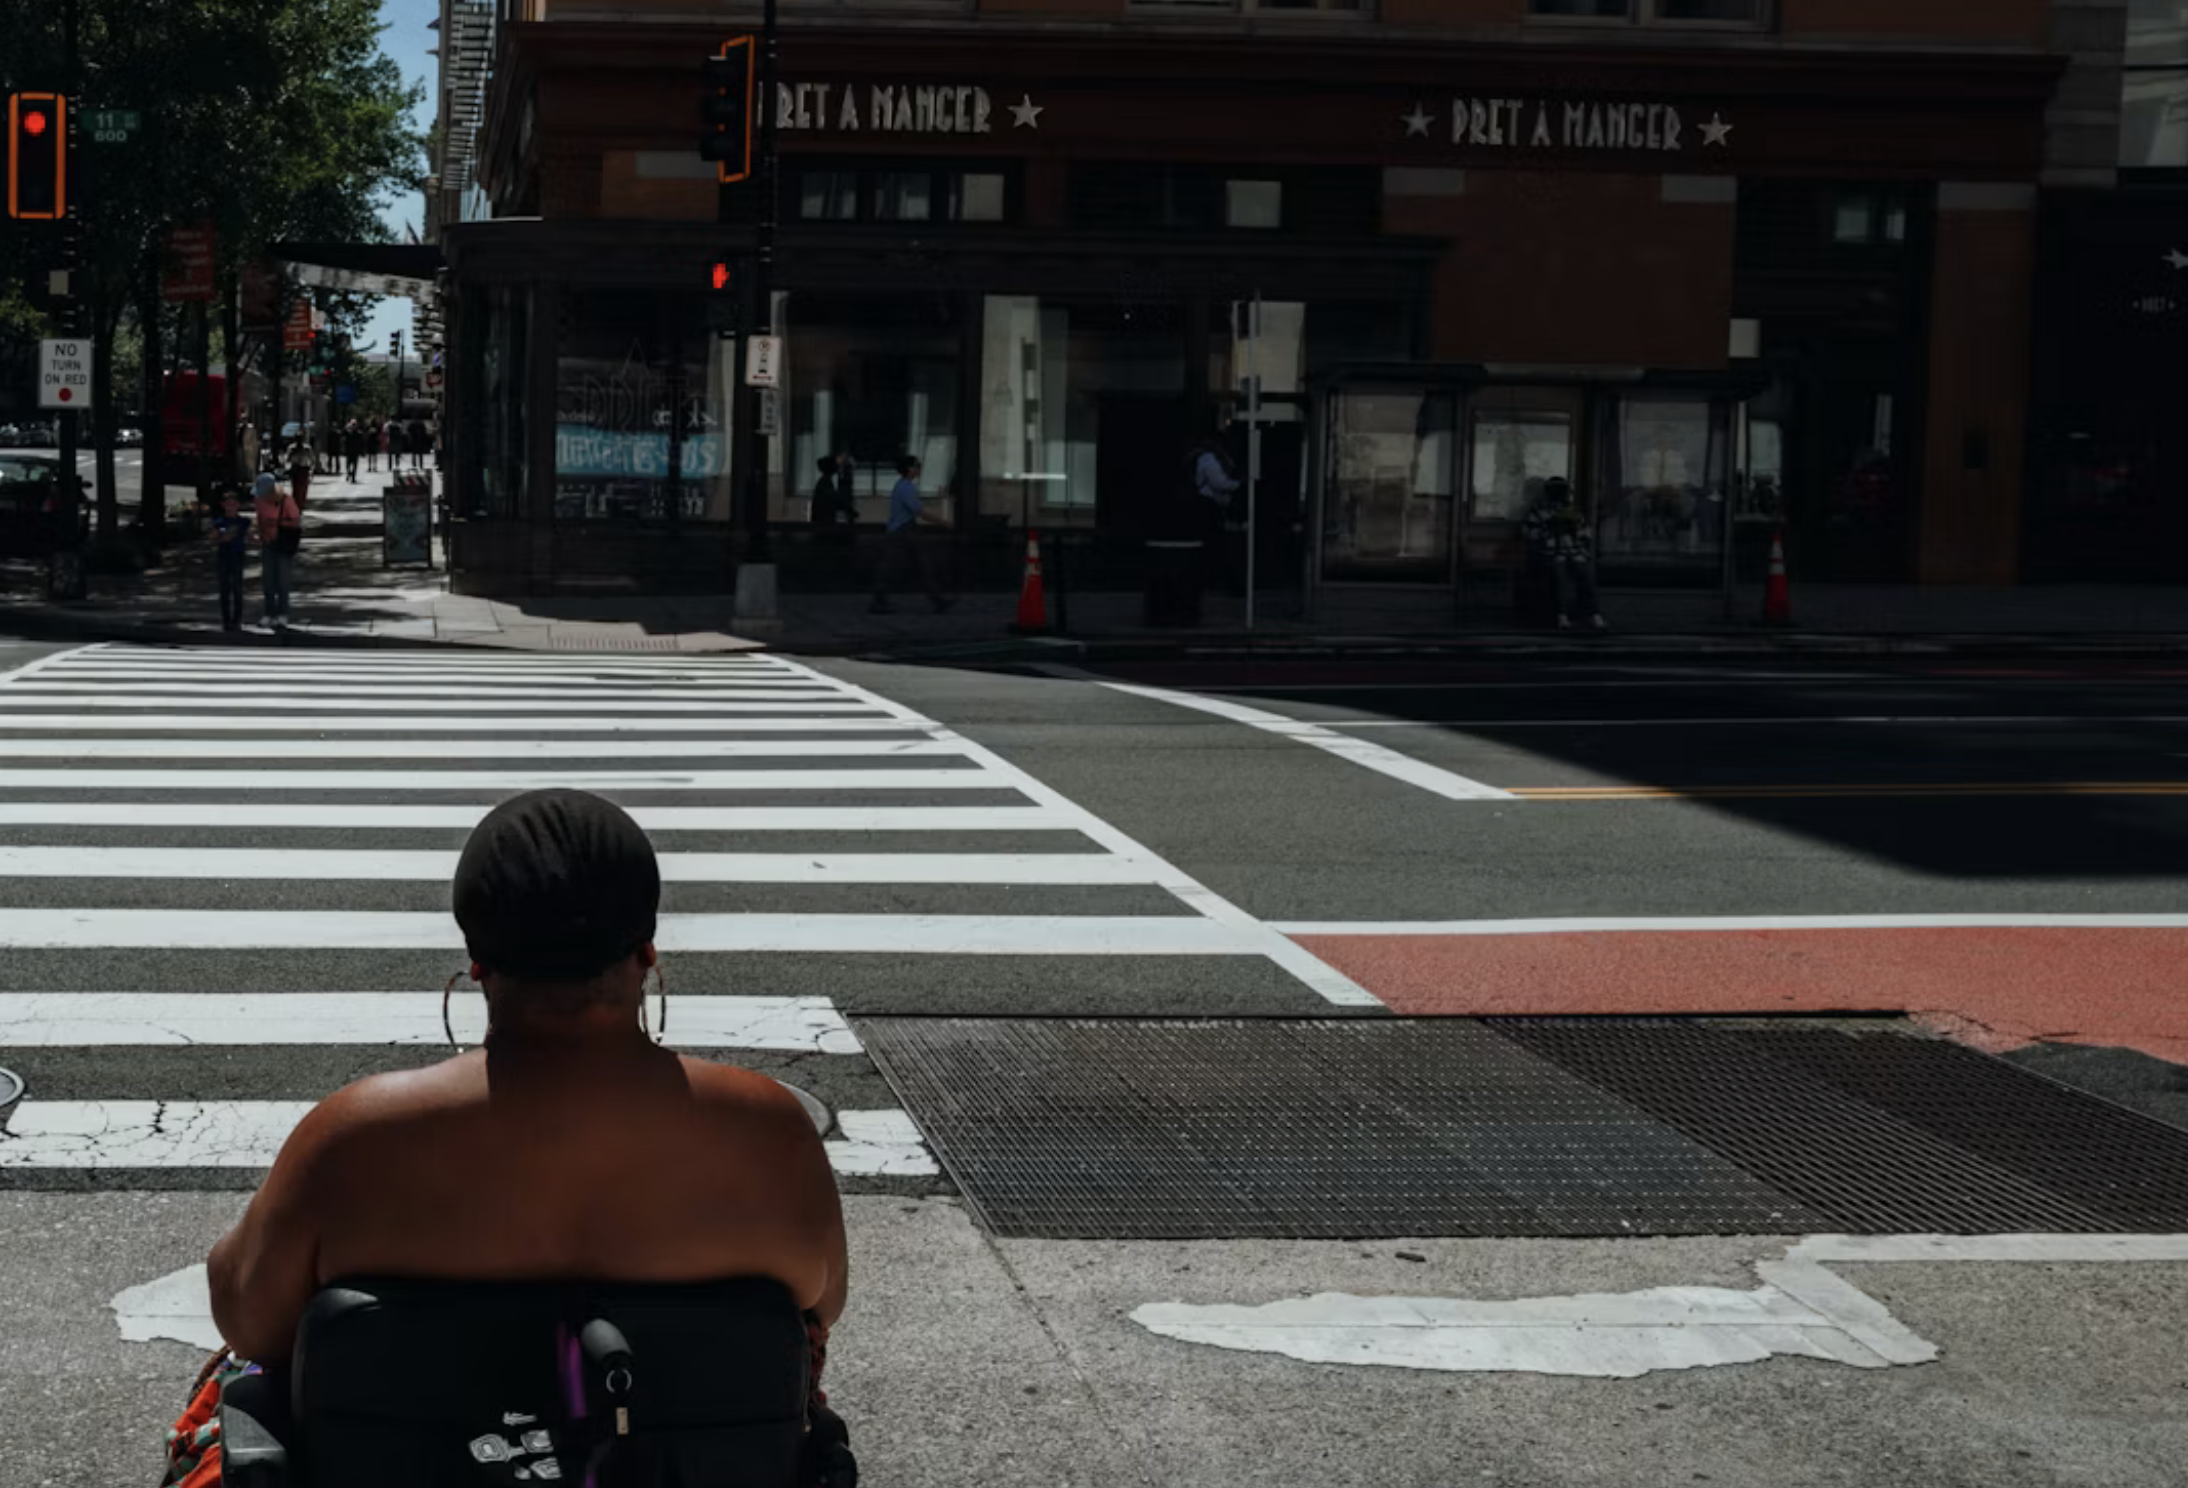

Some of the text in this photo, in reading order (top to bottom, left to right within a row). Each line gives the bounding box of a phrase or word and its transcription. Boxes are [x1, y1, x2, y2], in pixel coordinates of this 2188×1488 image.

[839, 83, 860, 131] A
[871, 84, 992, 133] MANGER
[95, 112, 114, 129] 11
[1451, 97, 1523, 146] PRET
[1562, 101, 1682, 151] MANGER
[93, 129, 128, 143] 600
[55, 343, 77, 356] NO
[52, 359, 81, 371] TURN
[45, 373, 87, 385] ON RED
